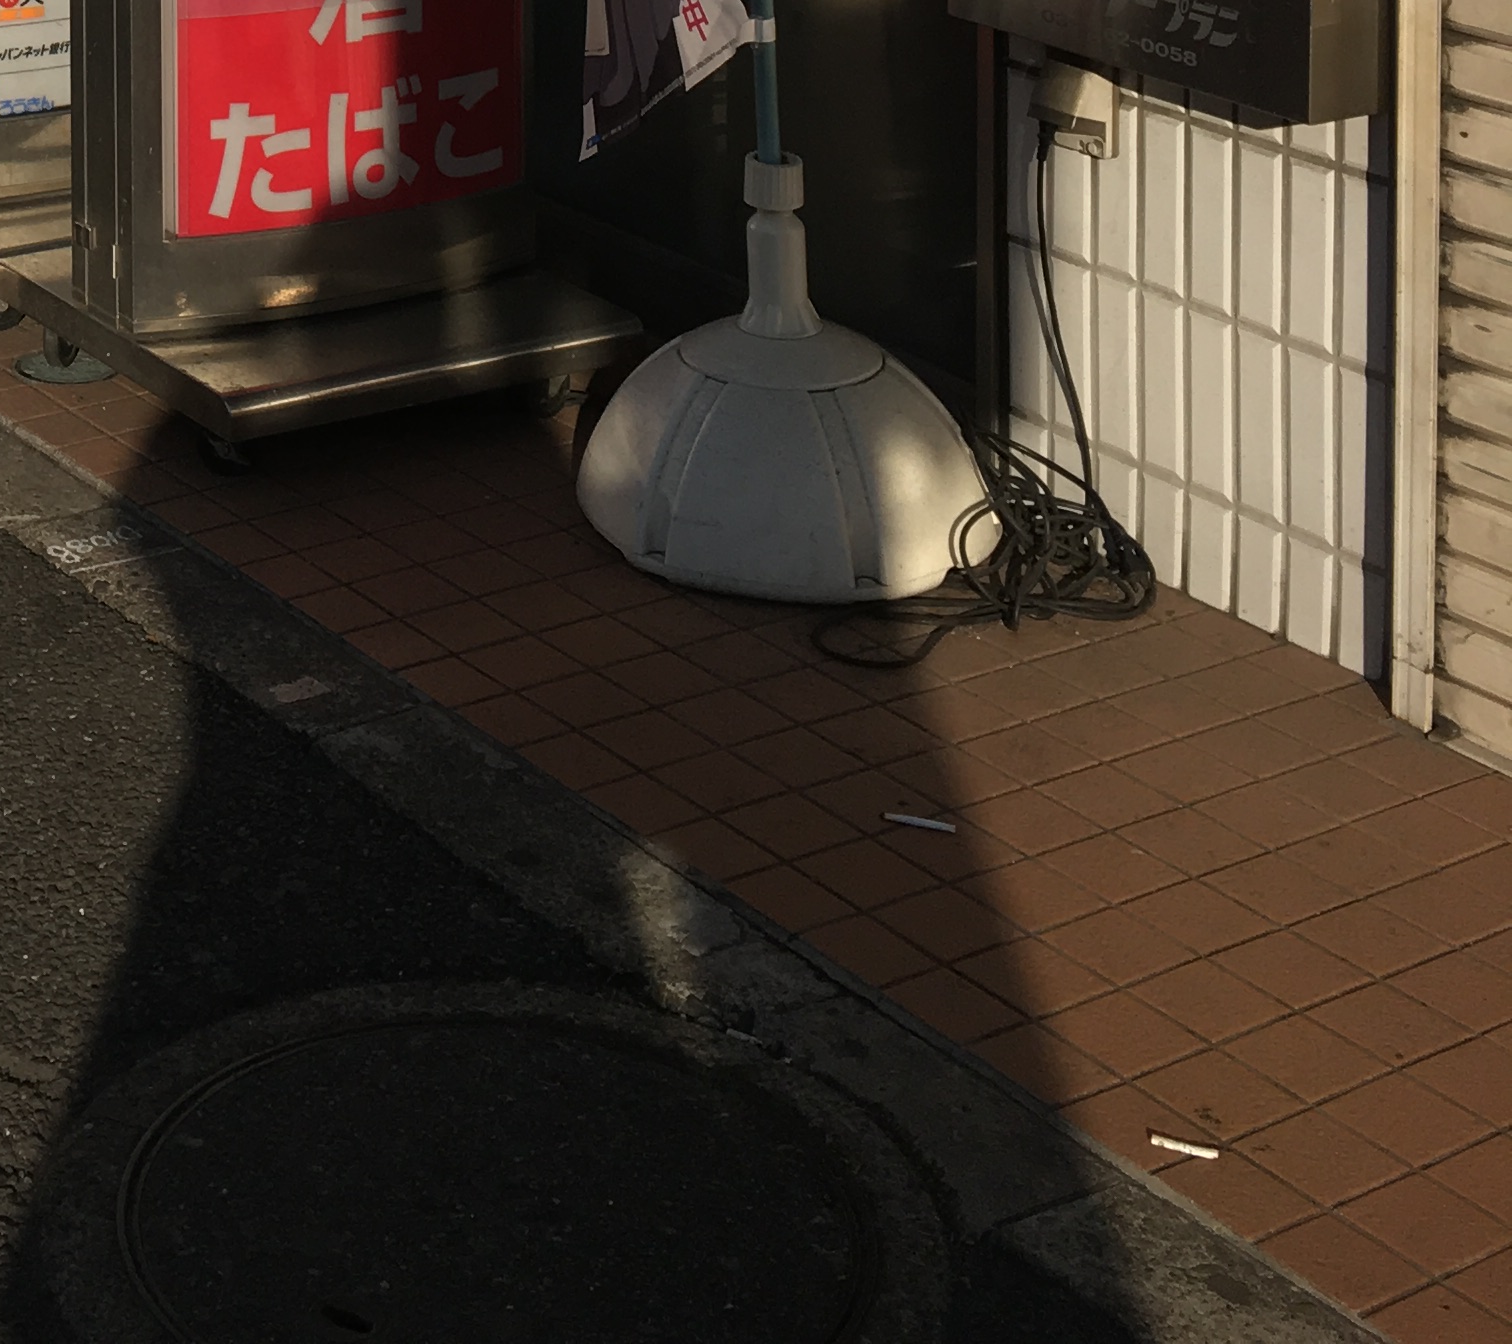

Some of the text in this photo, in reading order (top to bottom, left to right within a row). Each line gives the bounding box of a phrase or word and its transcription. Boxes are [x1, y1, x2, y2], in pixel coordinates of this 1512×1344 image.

[0, 95, 55, 116] ろうきん
[209, 65, 504, 221] たばこ
